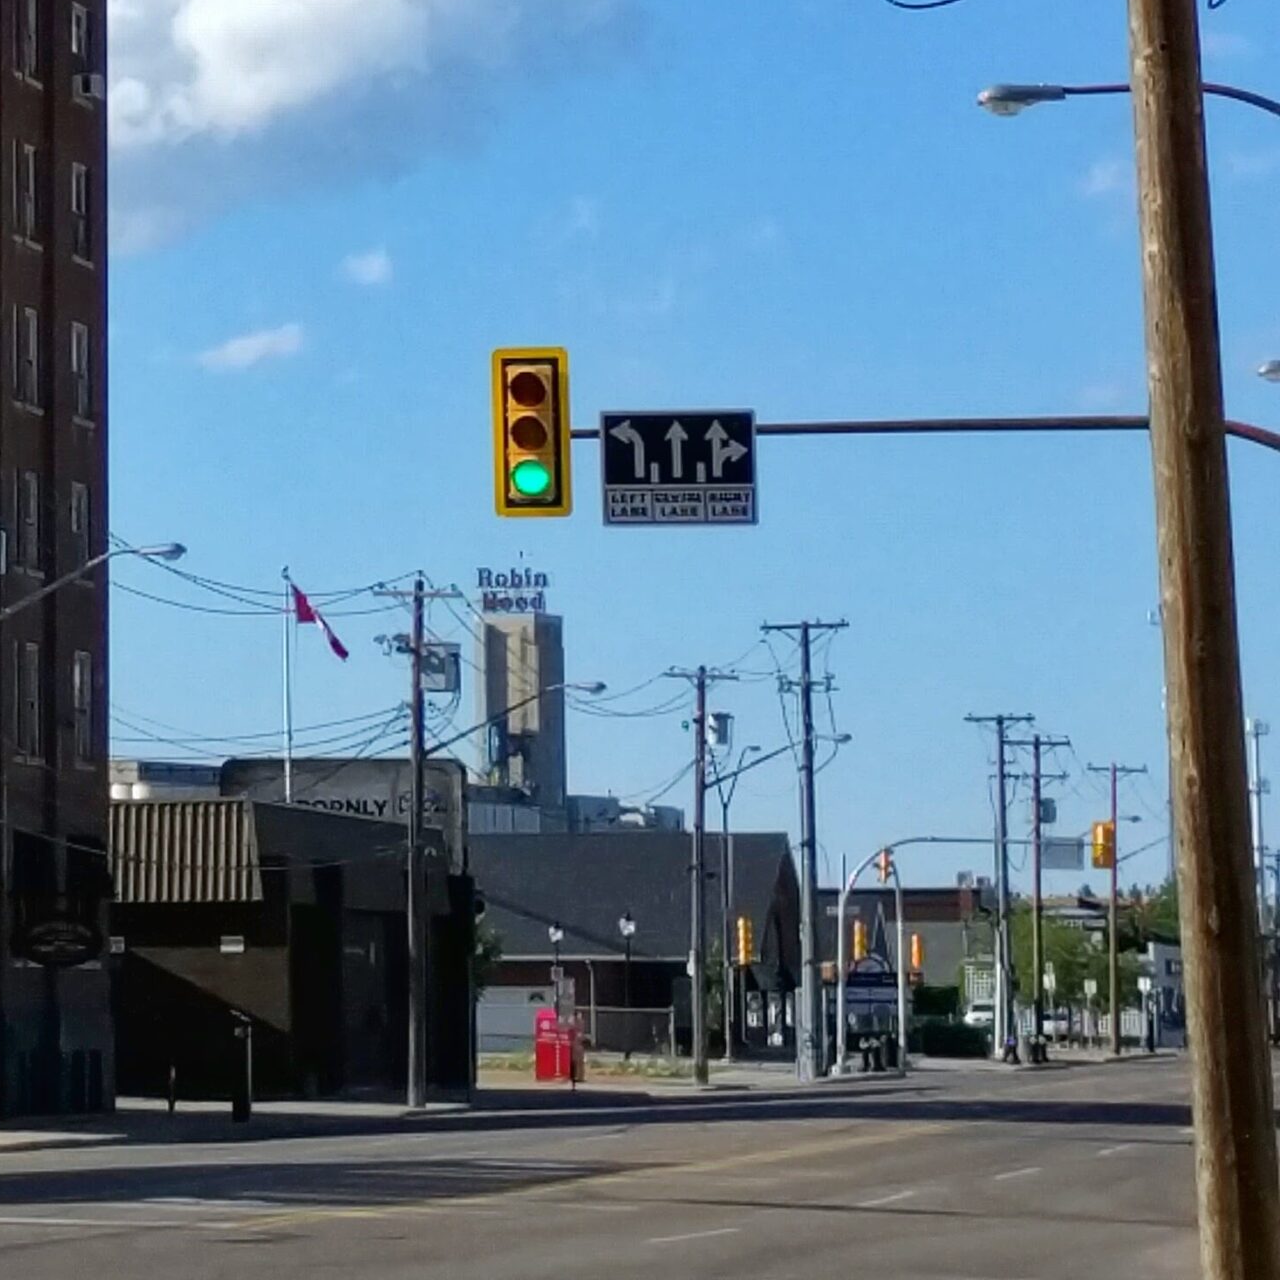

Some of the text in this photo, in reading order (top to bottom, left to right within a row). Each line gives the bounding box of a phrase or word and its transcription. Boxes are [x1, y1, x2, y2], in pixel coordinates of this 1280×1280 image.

[610, 493, 647, 504] LEFT
[610, 506, 648, 518] LANE
[661, 506, 699, 518] LANE
[711, 506, 749, 518] LANE
[476, 567, 550, 590] Robin
[482, 590, 546, 614] Hood
